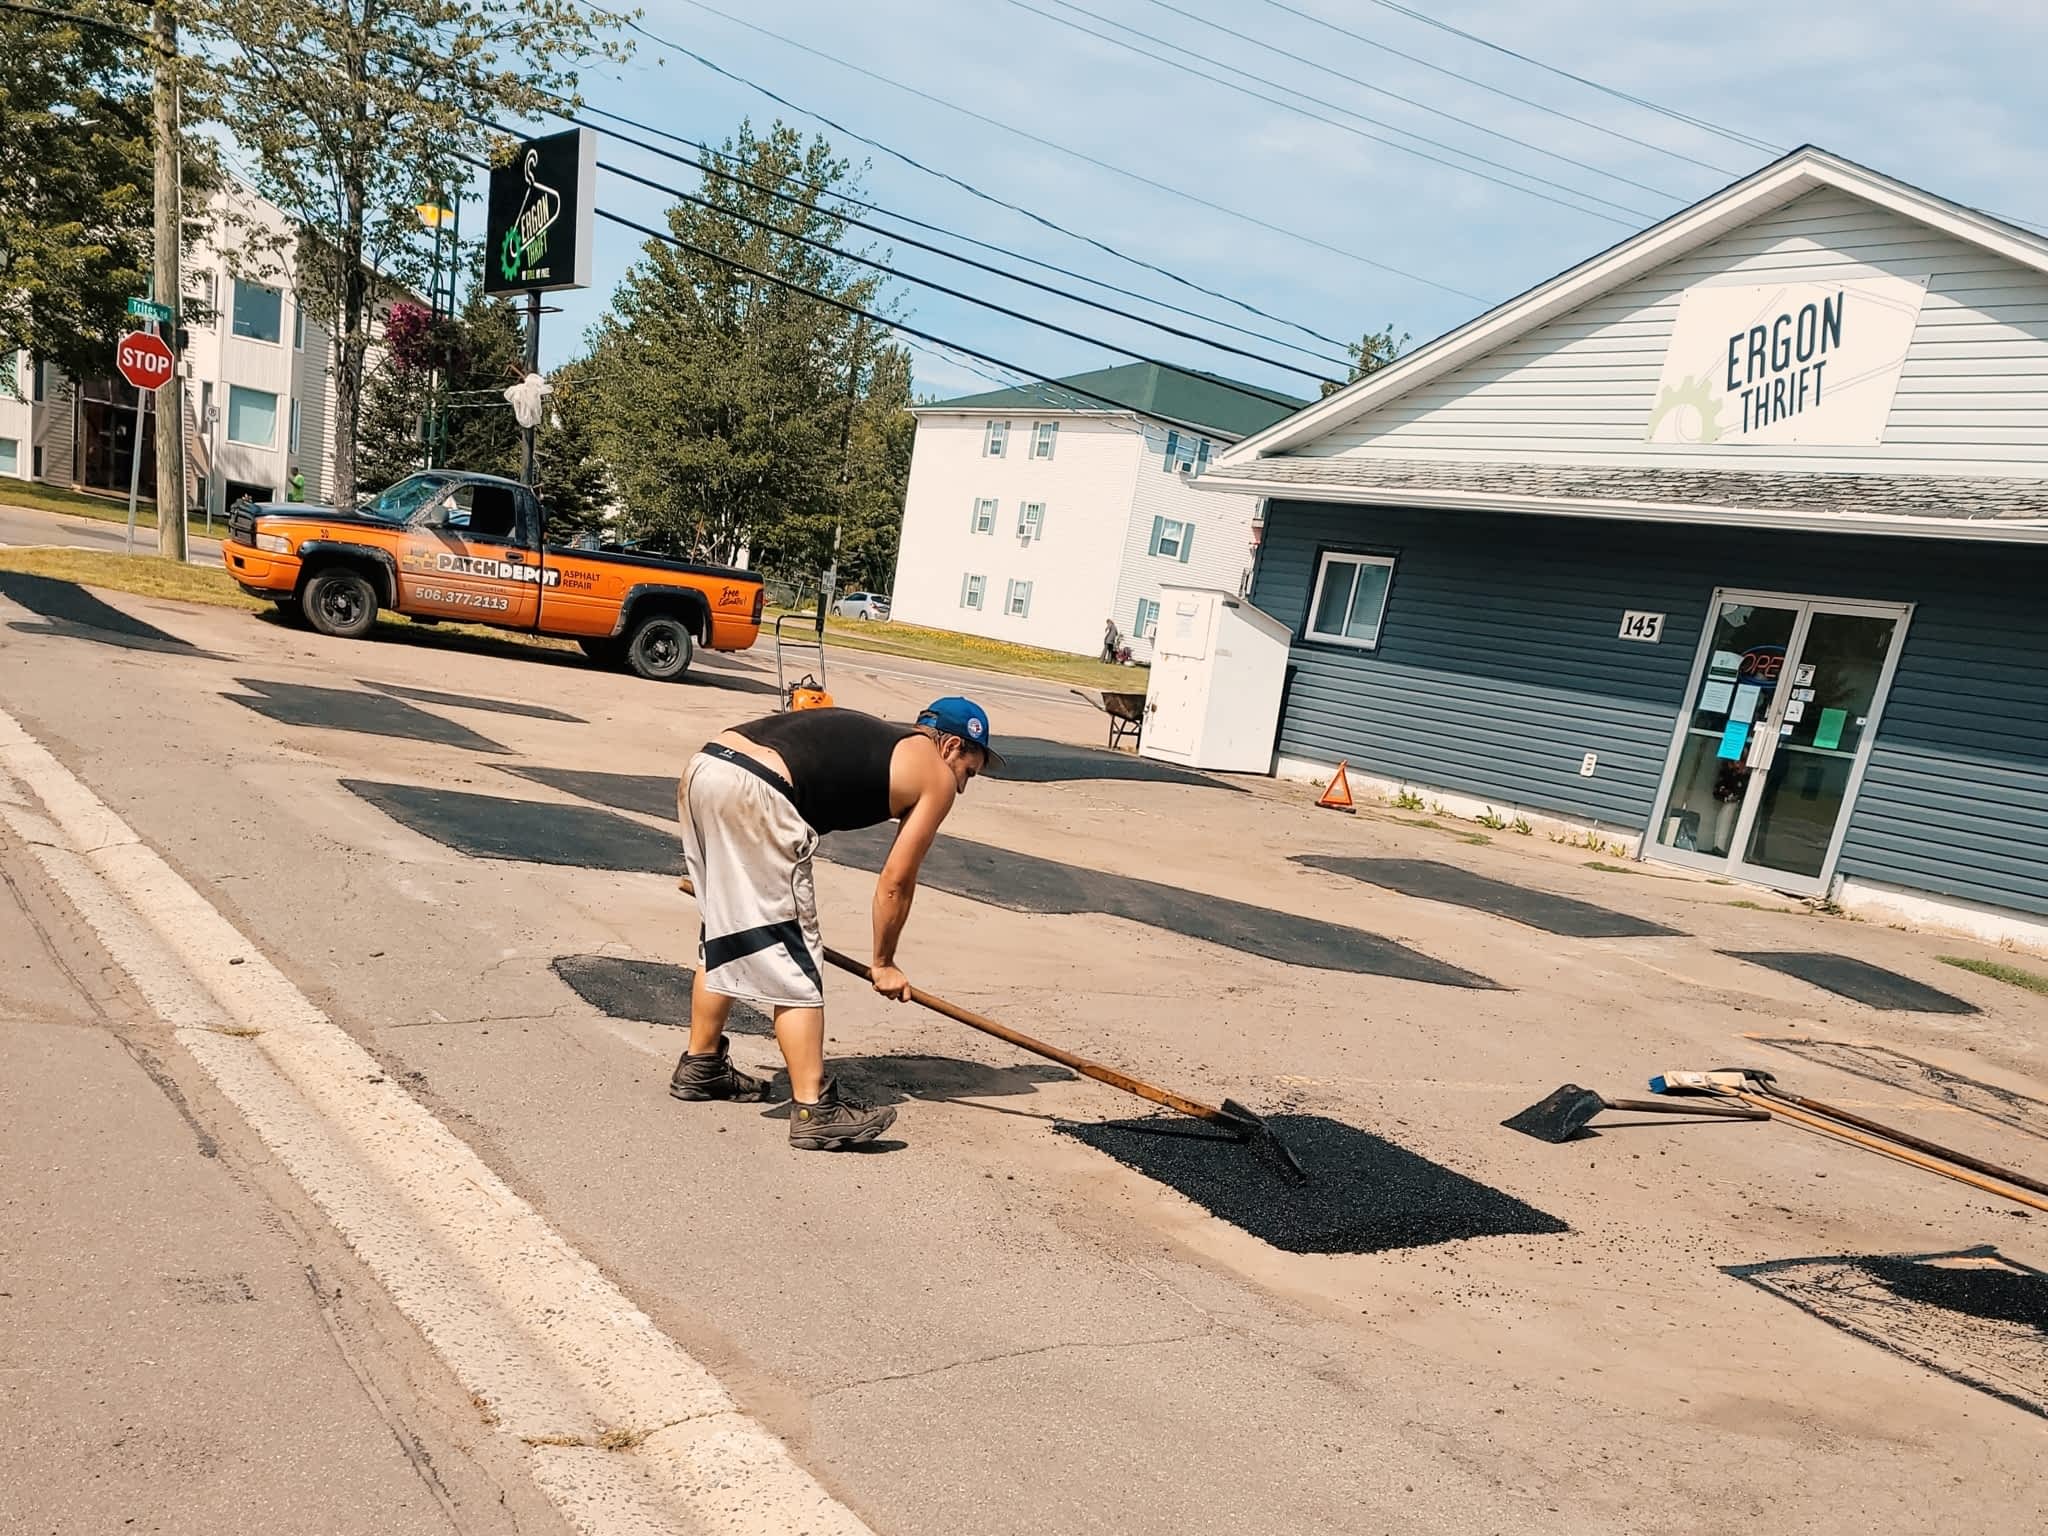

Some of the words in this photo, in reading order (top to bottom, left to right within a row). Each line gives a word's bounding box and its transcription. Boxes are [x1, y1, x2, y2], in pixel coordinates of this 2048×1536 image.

[521, 192, 549, 244] ERGON
[132, 301, 158, 316] Trites
[1726, 291, 1844, 392] ERGON
[122, 347, 169, 374] STOP
[1740, 360, 1827, 434] THRIFT
[438, 555, 496, 576] PATCH
[499, 563, 560, 586] DEPOT
[563, 570, 600, 582] ASPHALT
[563, 579, 592, 590] REPAIR
[722, 586, 739, 597] Free
[415, 587, 508, 610] 506.377.2113
[1623, 616, 1658, 638] 145
[1743, 653, 1785, 677] OPE
